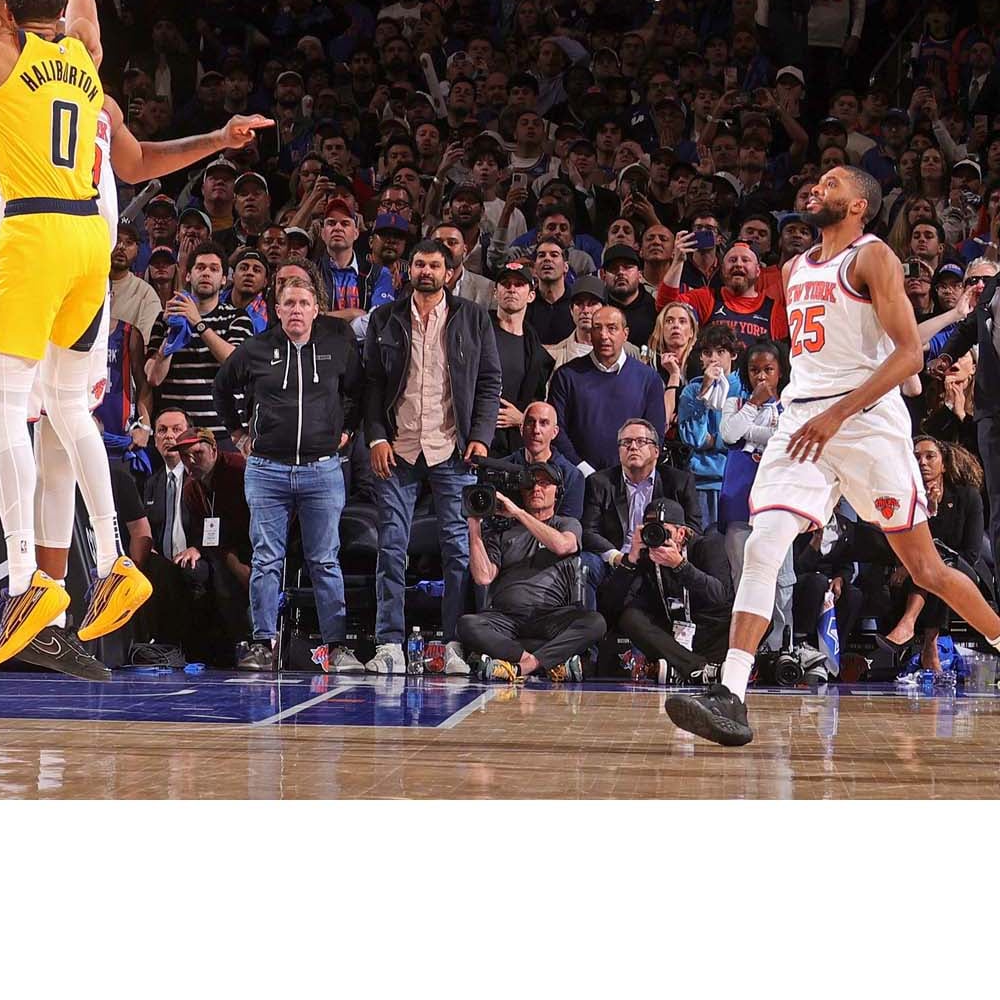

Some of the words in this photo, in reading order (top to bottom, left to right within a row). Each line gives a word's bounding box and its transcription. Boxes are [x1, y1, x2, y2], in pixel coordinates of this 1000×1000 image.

[19, 60, 98, 103] HALIBURTON
[52, 99, 79, 169] 0
[789, 305, 826, 359] 25
